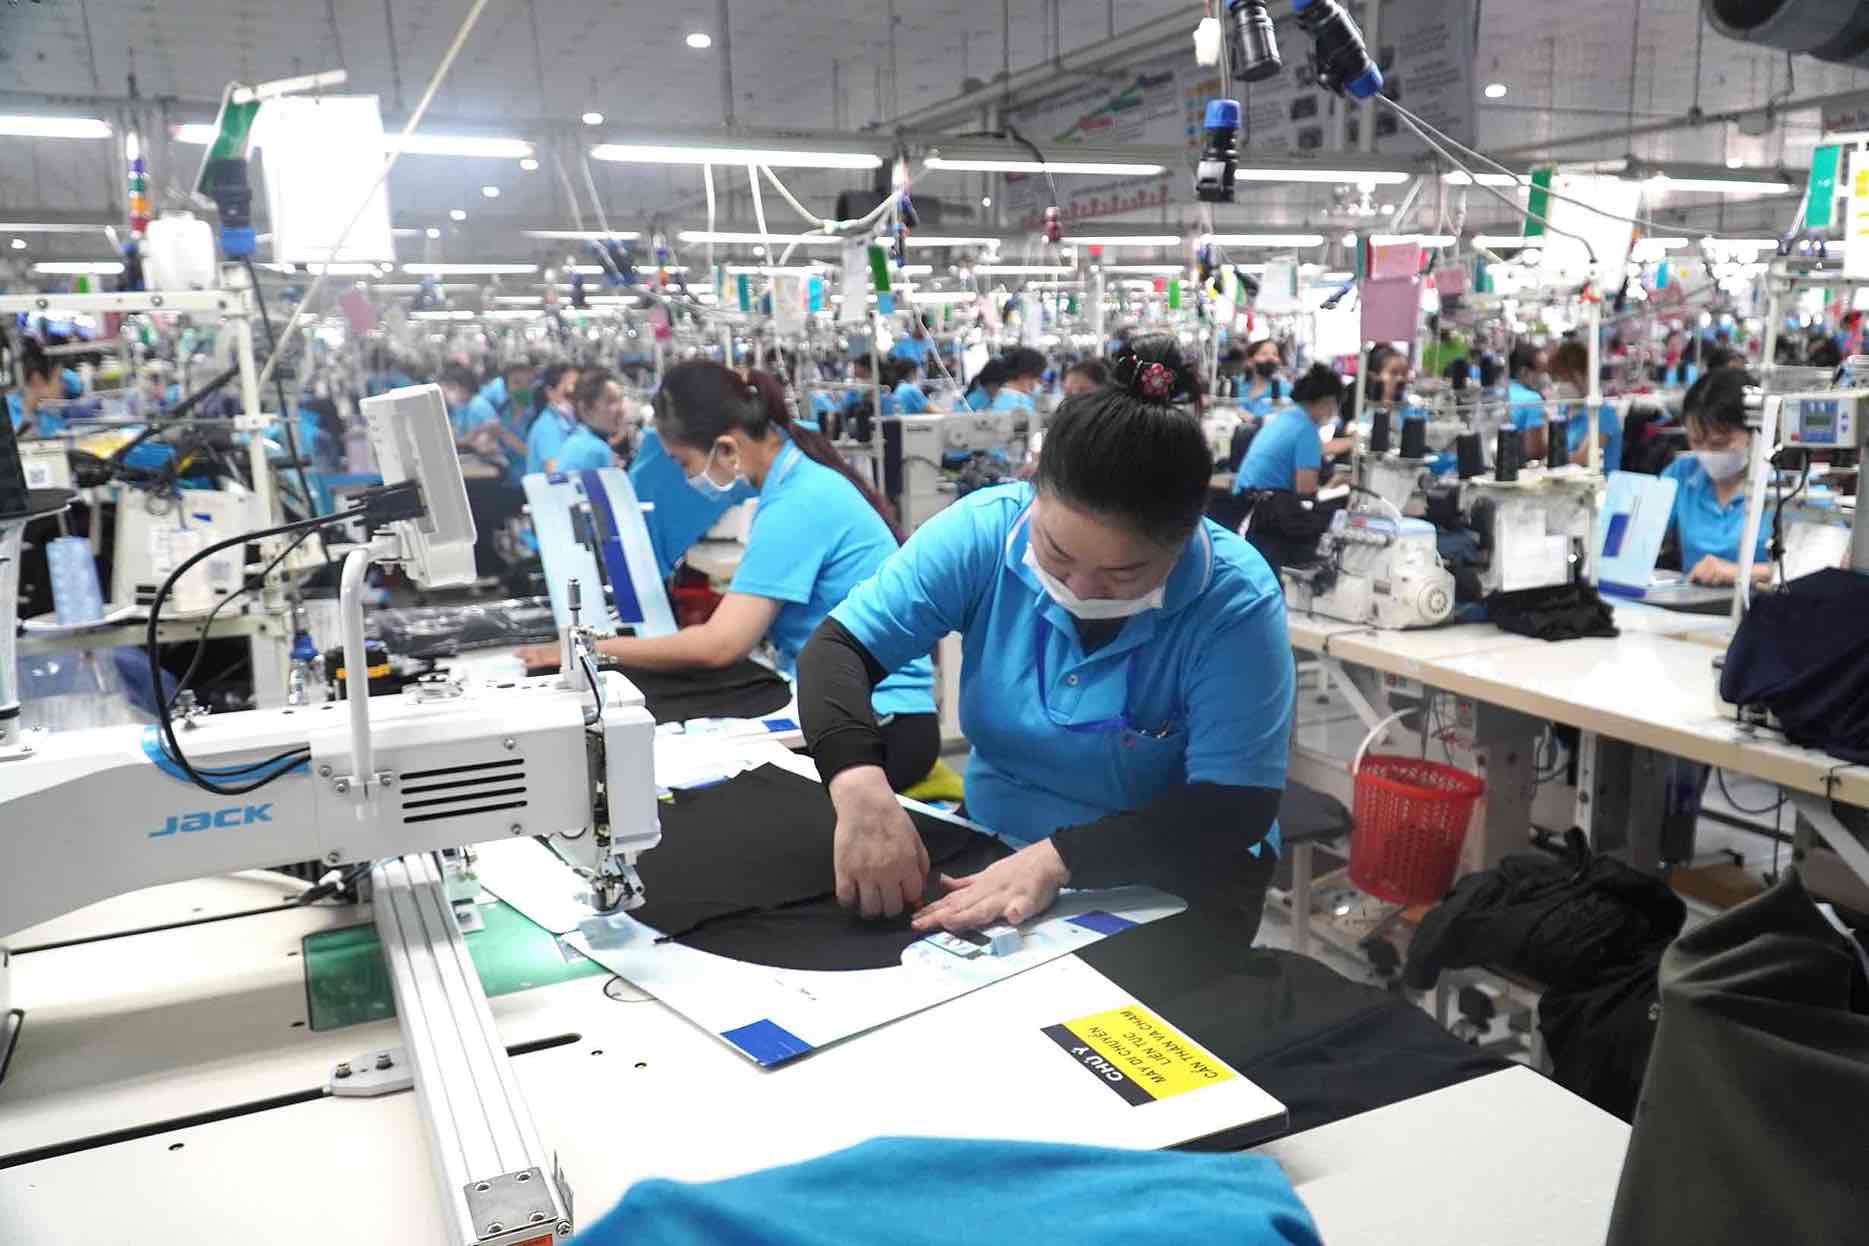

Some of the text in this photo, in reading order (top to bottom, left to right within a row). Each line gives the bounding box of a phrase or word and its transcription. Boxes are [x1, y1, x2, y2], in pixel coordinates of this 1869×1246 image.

[1071, 1046, 1124, 1082] CHÚ Ý
[1127, 1056, 1144, 1066] DI
[1143, 1047, 1172, 1065] LIÊN
[1141, 1066, 1167, 1083] MÁY
